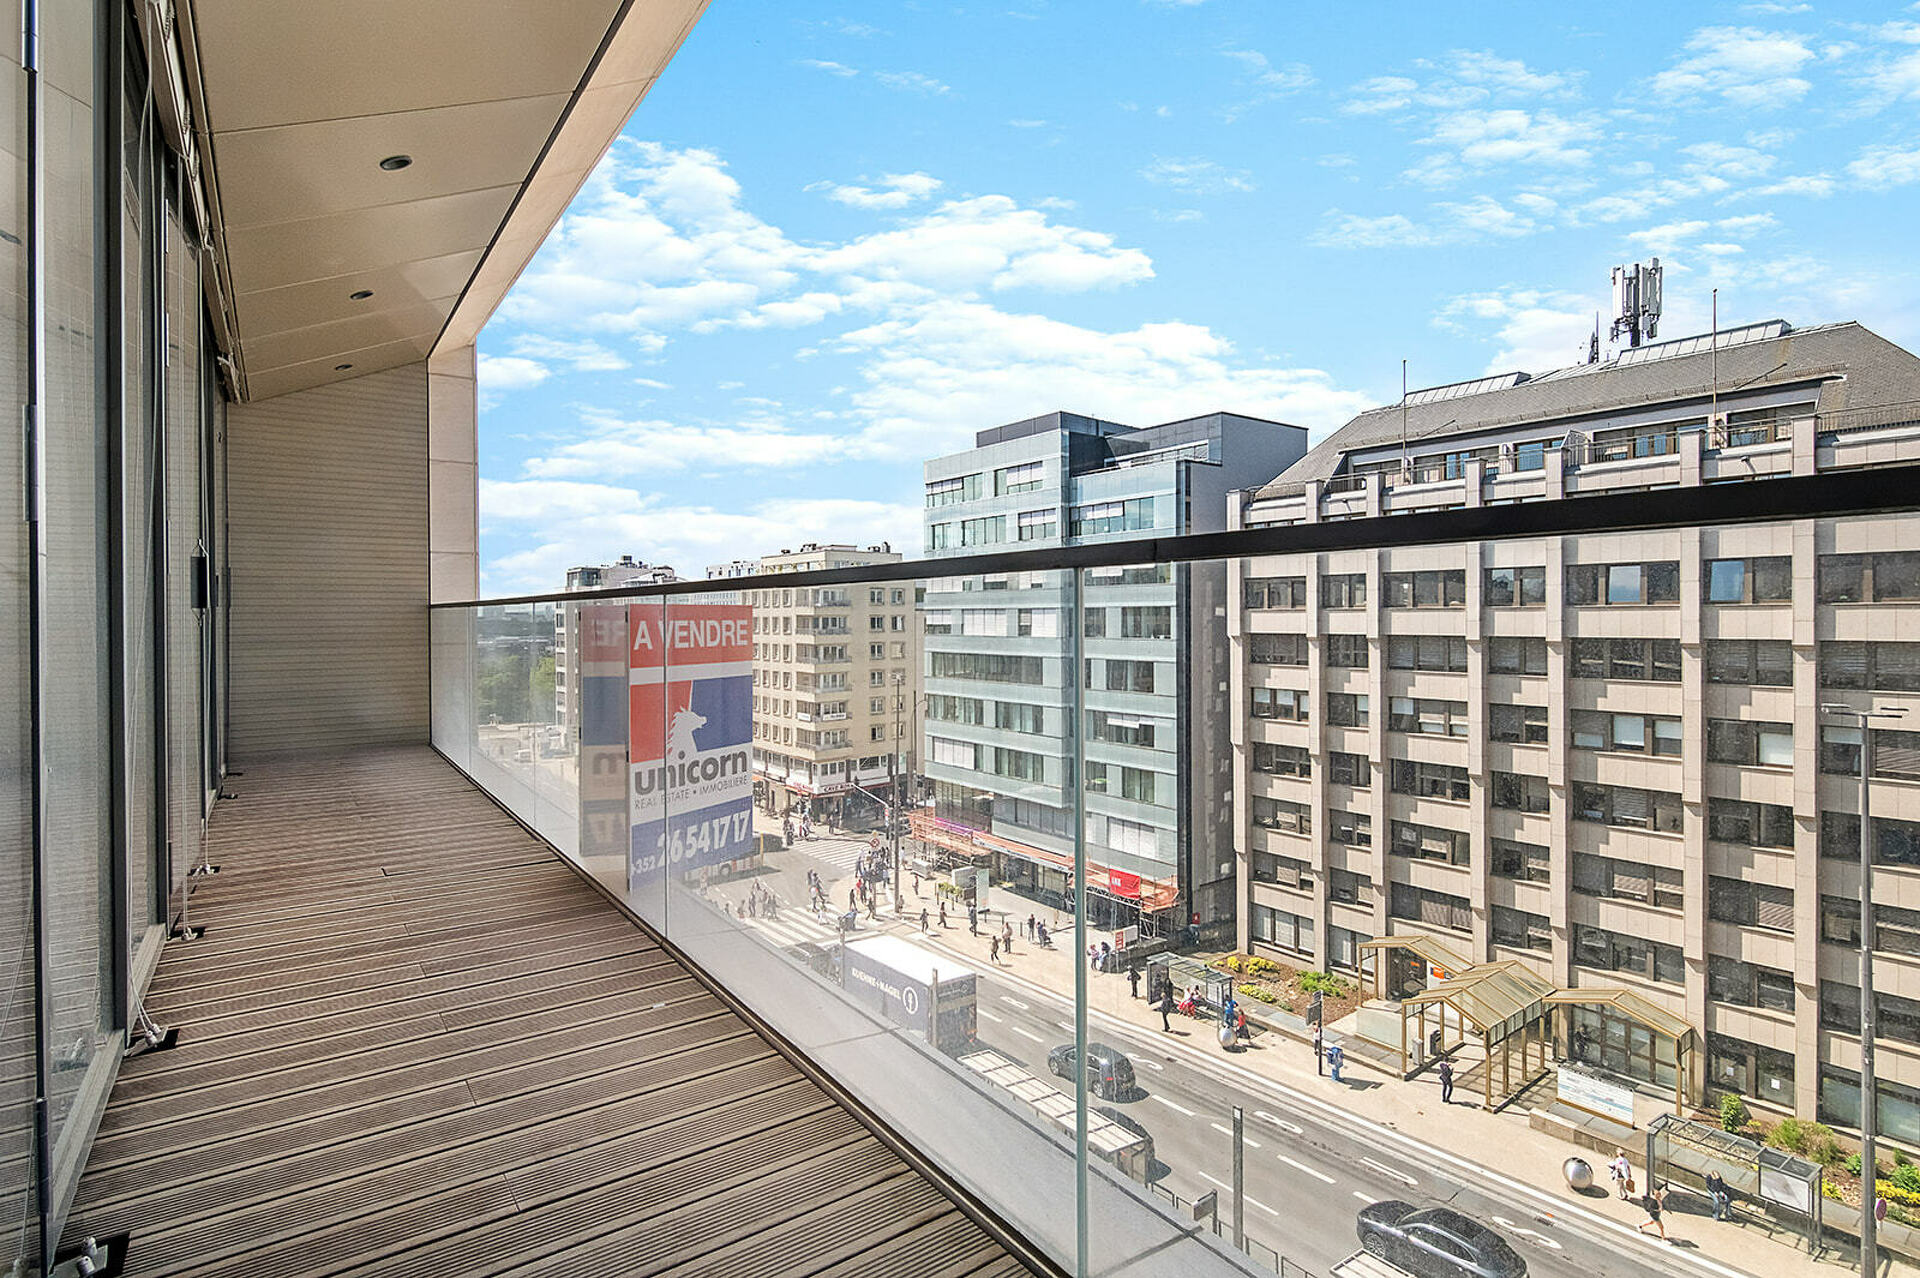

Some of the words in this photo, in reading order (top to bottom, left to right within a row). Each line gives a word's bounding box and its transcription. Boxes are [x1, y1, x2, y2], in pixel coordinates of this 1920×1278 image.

[633, 620, 653, 650] A
[657, 619, 748, 648] VENDRE
[634, 750, 747, 795] unicorn
[661, 788, 690, 804] ESTATE
